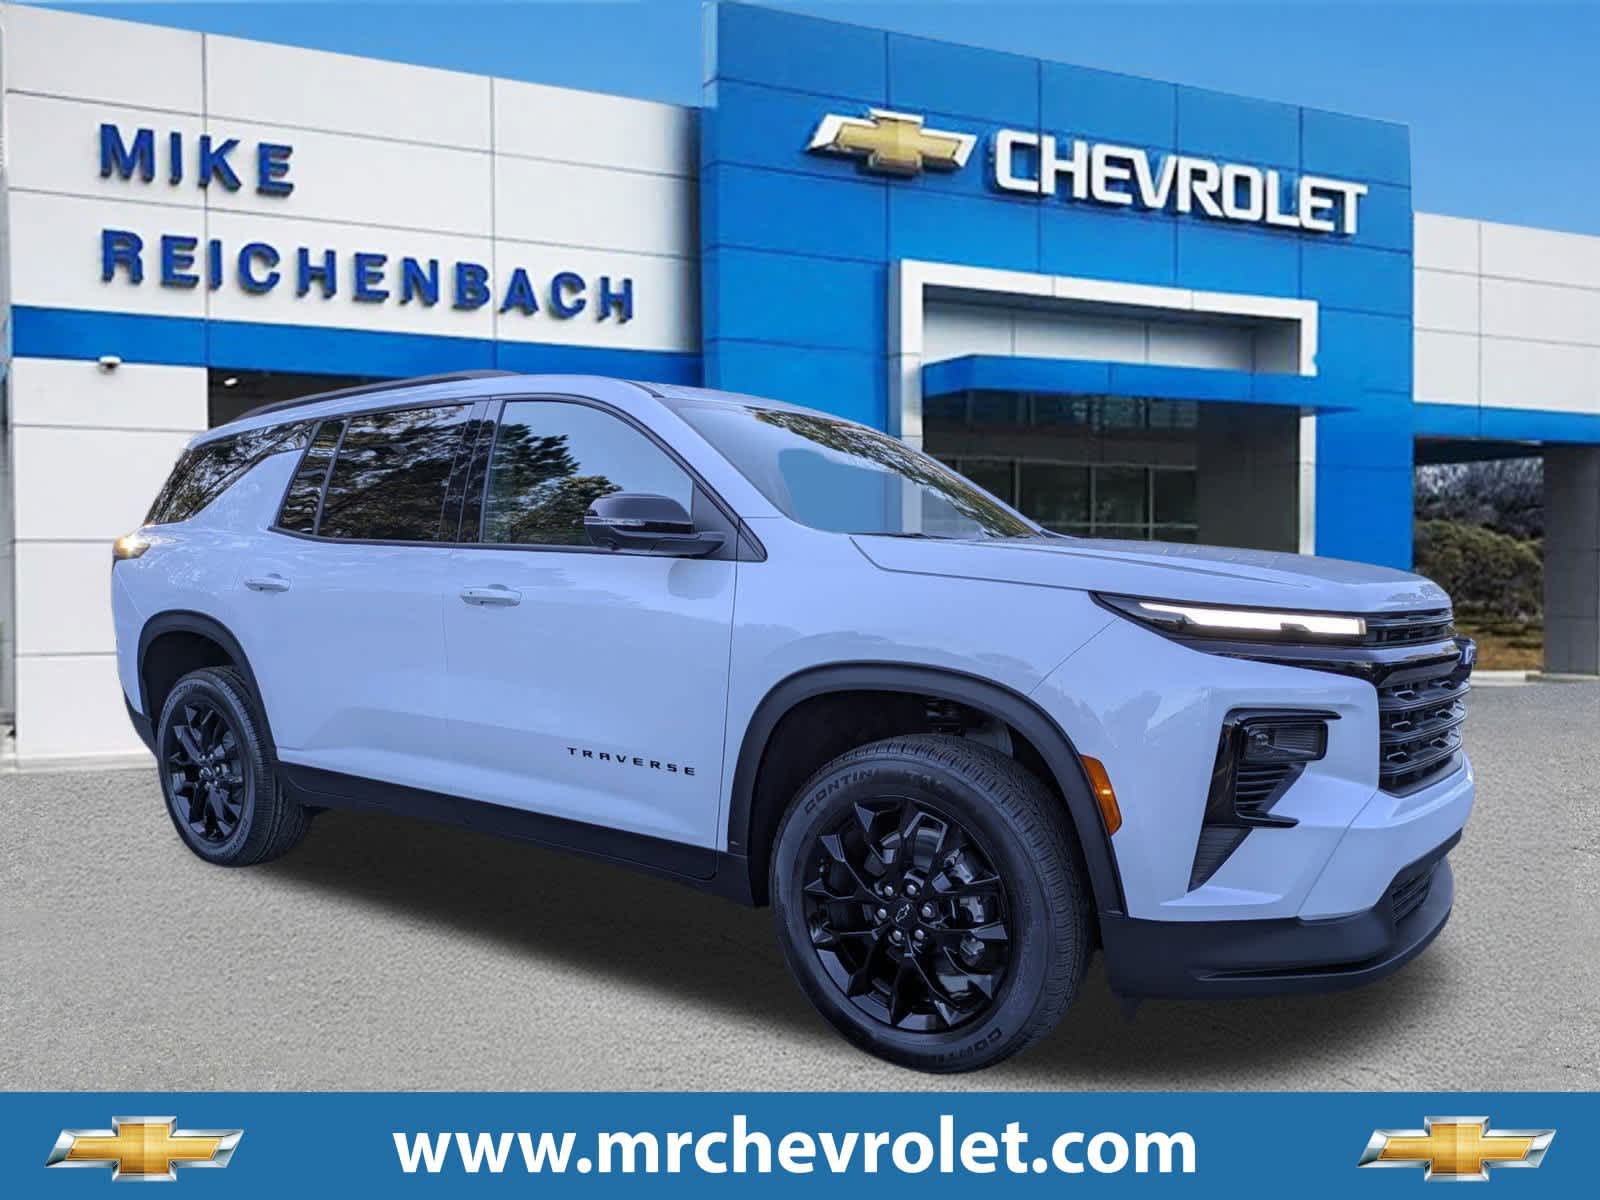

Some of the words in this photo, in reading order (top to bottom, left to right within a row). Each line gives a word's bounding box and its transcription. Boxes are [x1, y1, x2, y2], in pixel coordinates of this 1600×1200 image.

[99, 123, 295, 197] MIKE
[994, 129, 1368, 235] CHEVROLET
[101, 228, 634, 323] REICHENBACH
[567, 746, 696, 776] TRAVERSE
